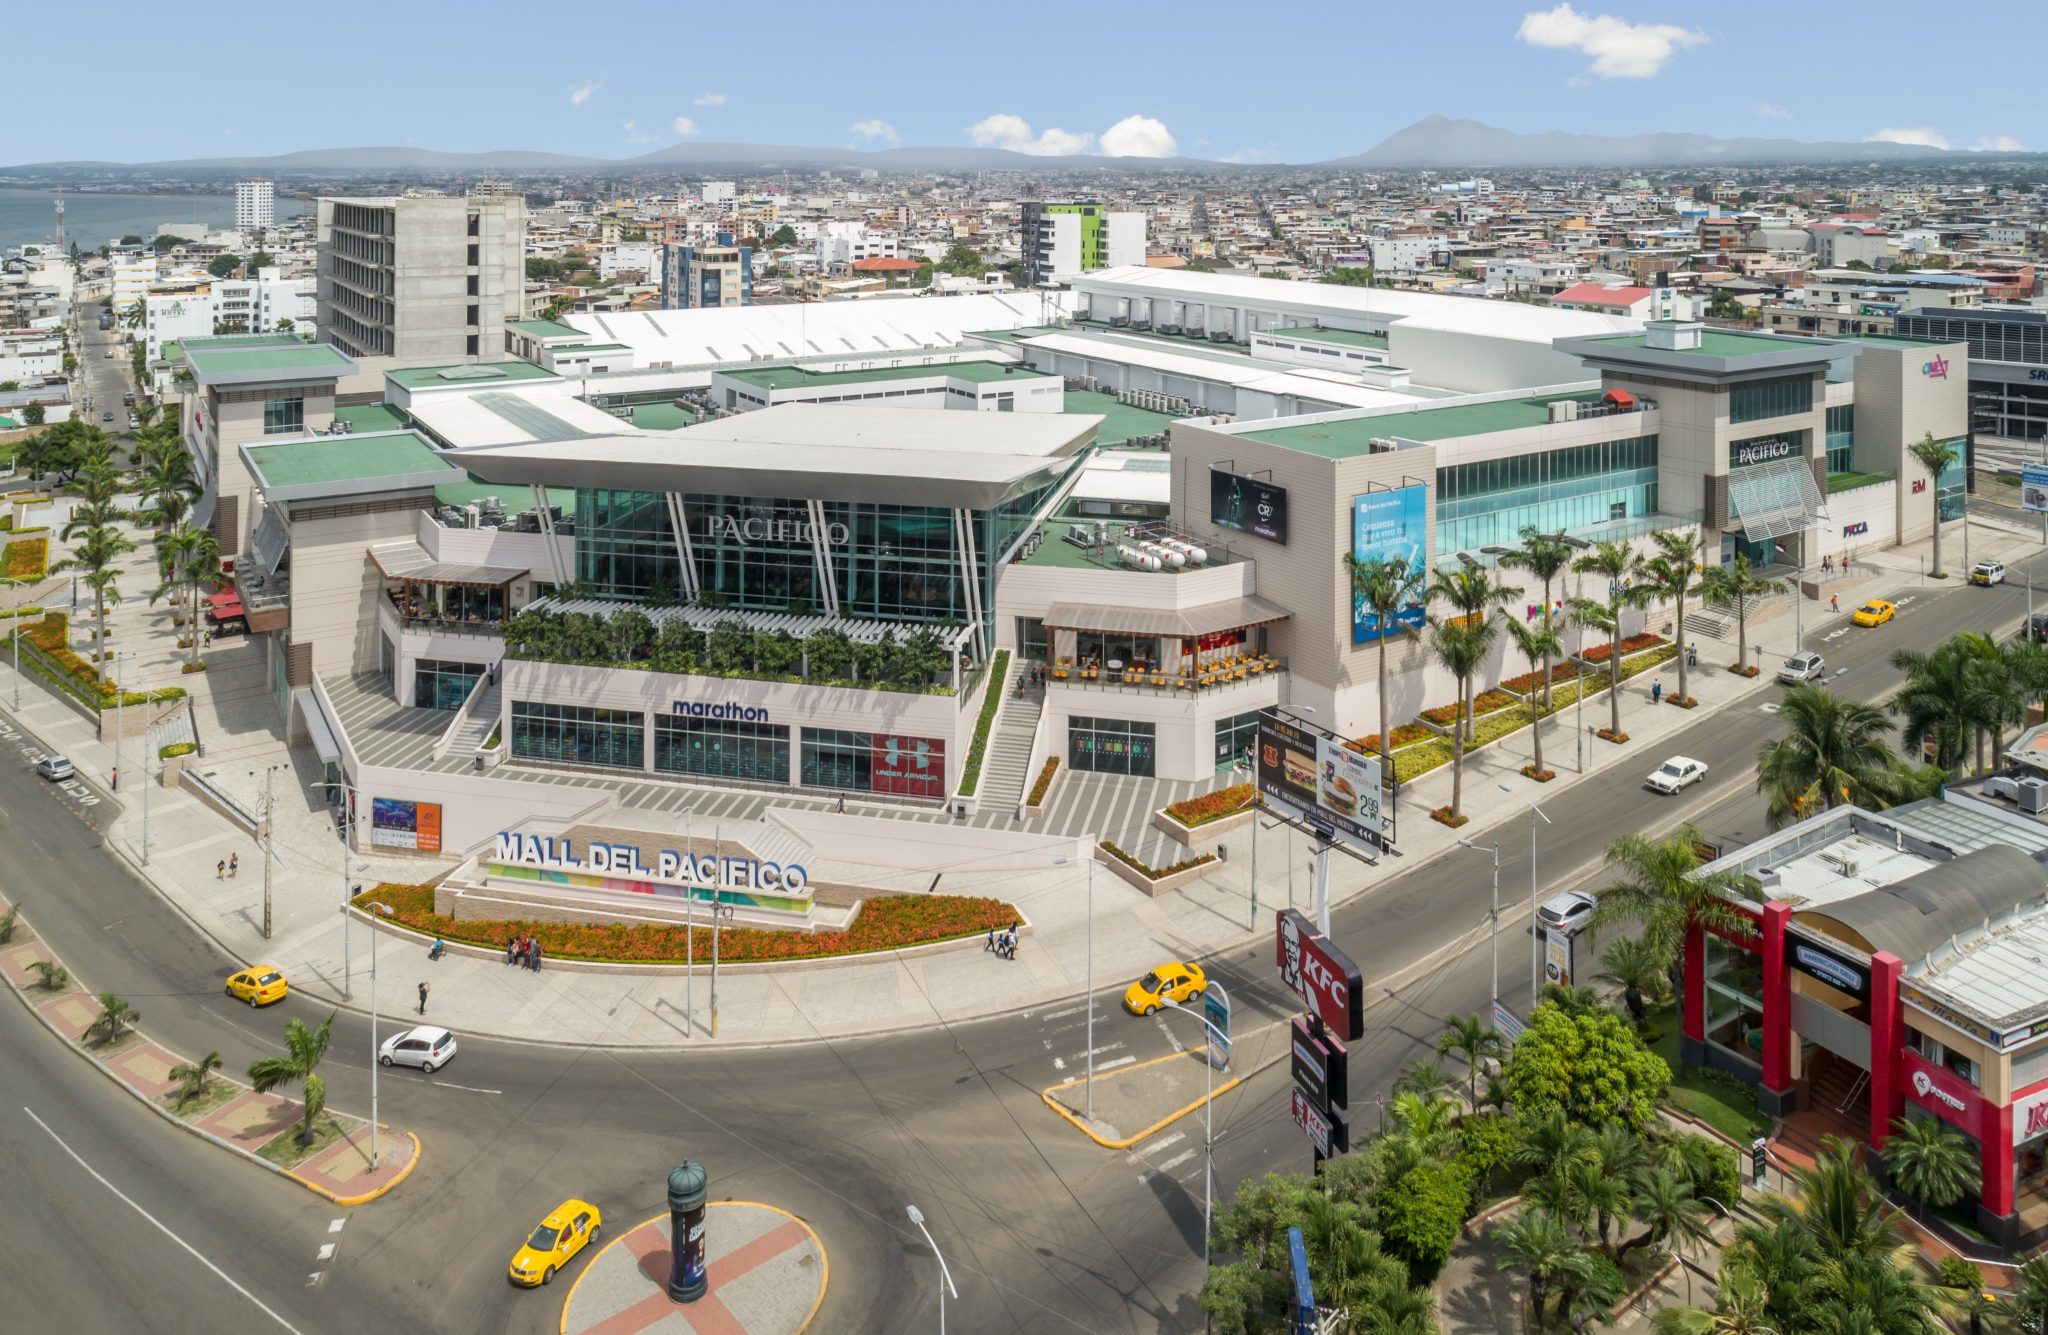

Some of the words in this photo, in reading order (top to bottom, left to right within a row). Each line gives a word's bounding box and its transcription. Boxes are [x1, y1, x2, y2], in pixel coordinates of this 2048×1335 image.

[1739, 441, 1789, 465] PACIFICO
[738, 505, 777, 514] MALL
[789, 508, 807, 516] DE
[1257, 503, 1274, 517] CR7
[708, 514, 850, 546] PACIFICO
[1254, 526, 1277, 538] marathon
[1362, 520, 1395, 531] Comienza
[1362, 541, 1381, 552] mejor
[672, 700, 769, 722] marathon
[875, 769, 903, 778] UNDER
[903, 772, 938, 781] ARMOUR
[1346, 764, 1363, 776] COMBO
[58, 780, 100, 806] BUS
[495, 831, 582, 869] MALL
[588, 840, 650, 876] DEL
[658, 848, 808, 896] PACIFICO
[1804, 952, 1839, 973] AMERICAN
[1839, 968, 1856, 983] DELI
[1303, 951, 1347, 1009] KFC
[1309, 1112, 1327, 1139] KFC
